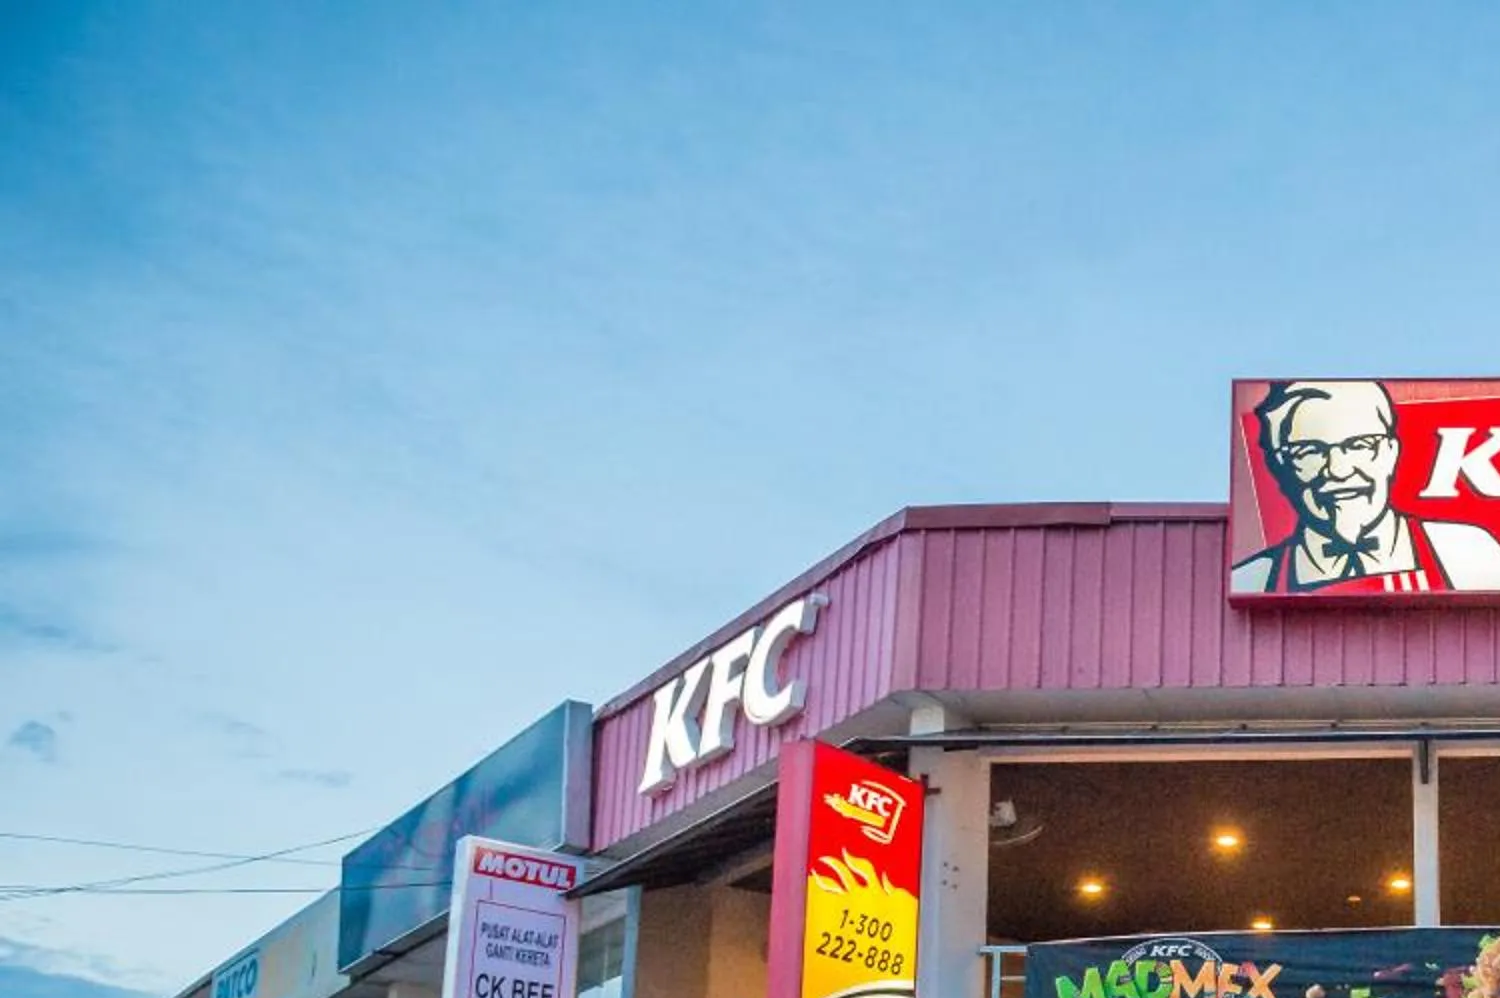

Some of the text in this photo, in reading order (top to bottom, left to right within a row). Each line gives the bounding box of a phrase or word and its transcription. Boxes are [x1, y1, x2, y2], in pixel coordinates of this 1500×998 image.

[638, 596, 829, 796] KFC
[847, 783, 893, 818] KFC
[478, 853, 571, 887] MOTUL
[839, 909, 893, 942] 1-300
[816, 932, 904, 975] 222-888
[1150, 945, 1193, 957] KFC
